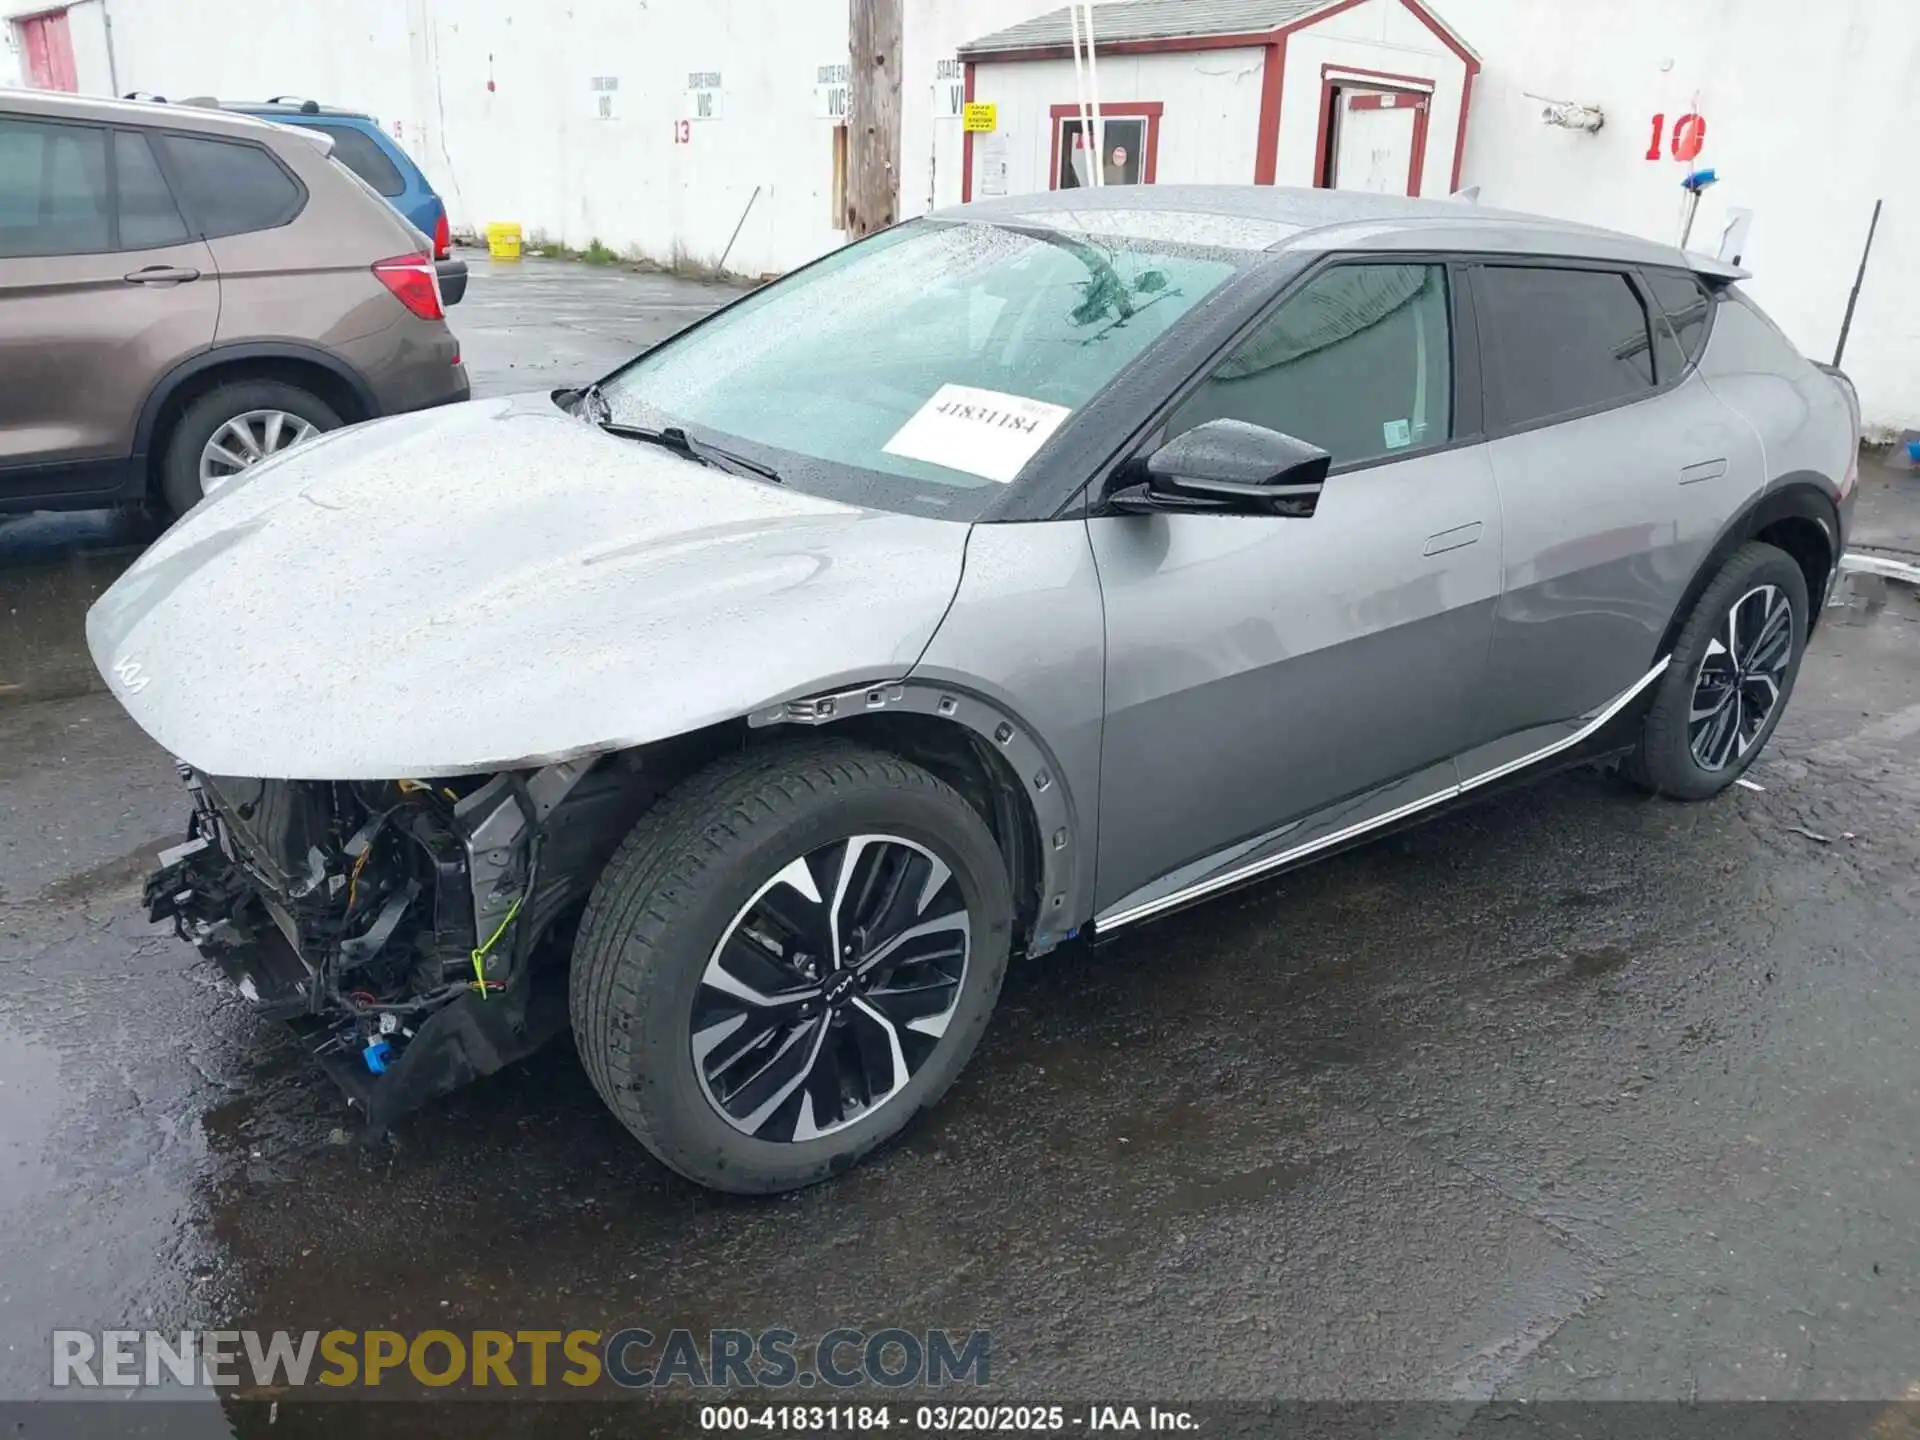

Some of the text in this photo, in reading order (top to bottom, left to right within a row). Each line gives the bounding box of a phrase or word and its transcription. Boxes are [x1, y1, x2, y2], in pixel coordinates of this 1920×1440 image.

[937, 59, 961, 80] STATE
[697, 93, 712, 117] VIC
[828, 88, 846, 116] VIC
[950, 85, 964, 115] VI
[674, 119, 690, 143] 13
[1645, 113, 1706, 161] 10
[936, 401, 1040, 434] 41831184
